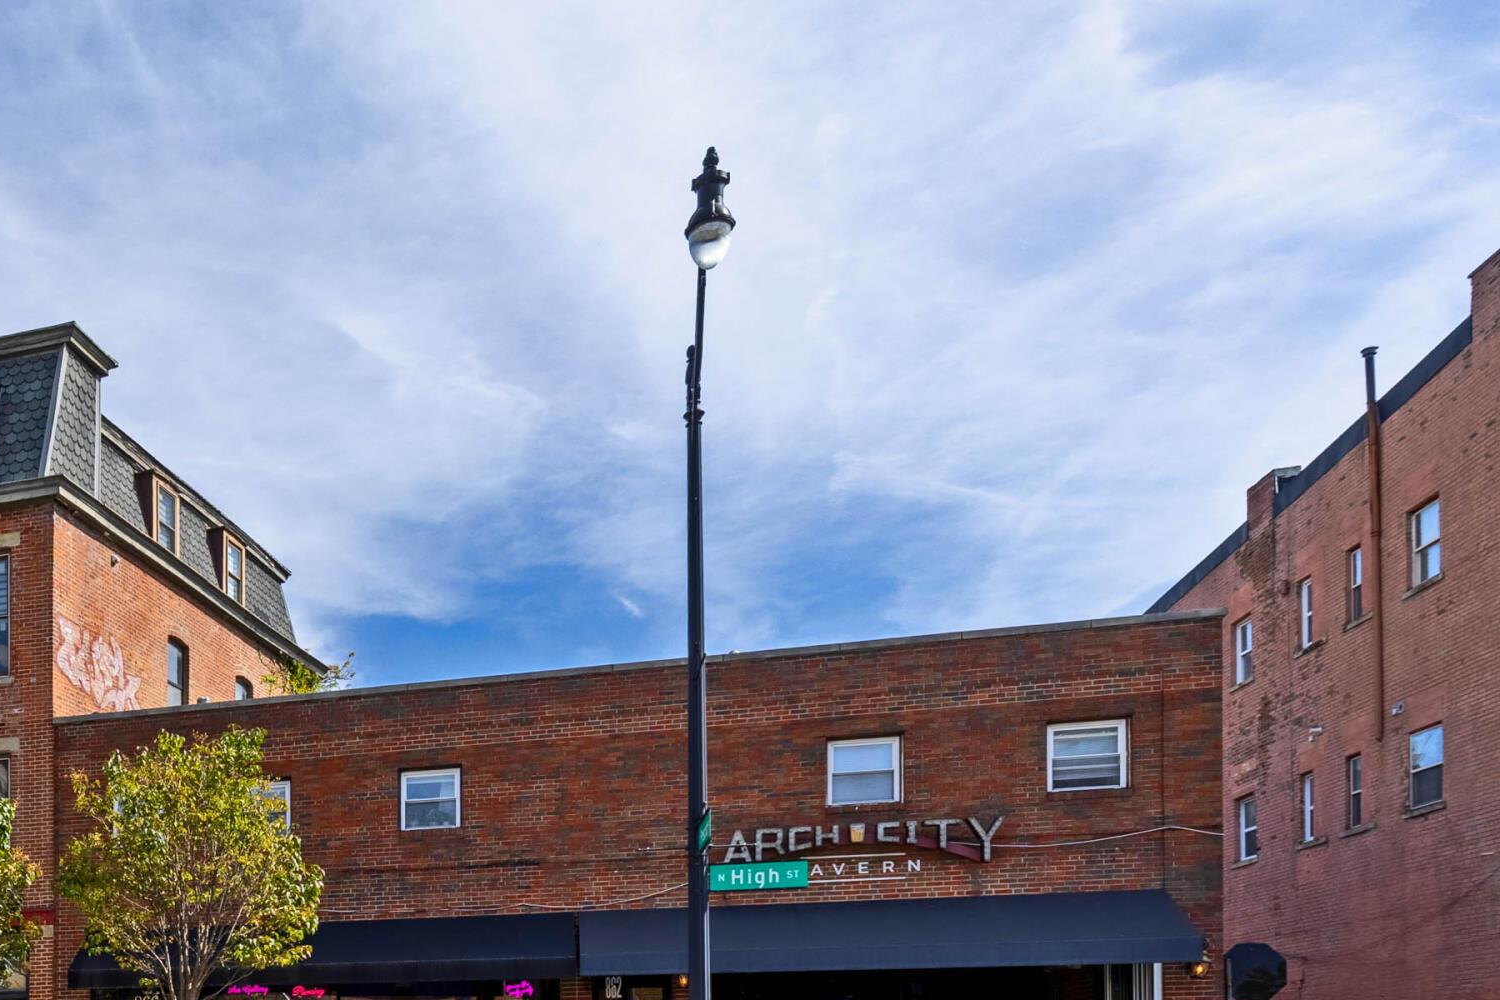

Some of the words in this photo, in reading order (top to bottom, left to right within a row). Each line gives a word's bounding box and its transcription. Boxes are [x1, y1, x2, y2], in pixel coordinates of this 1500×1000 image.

[723, 824, 840, 863] ARCH
[876, 816, 1005, 862] CITY
[718, 873, 725, 882] N
[731, 868, 779, 888] High
[786, 870, 799, 880] ST
[810, 859, 921, 877] AVERN
[605, 976, 622, 998] 862
